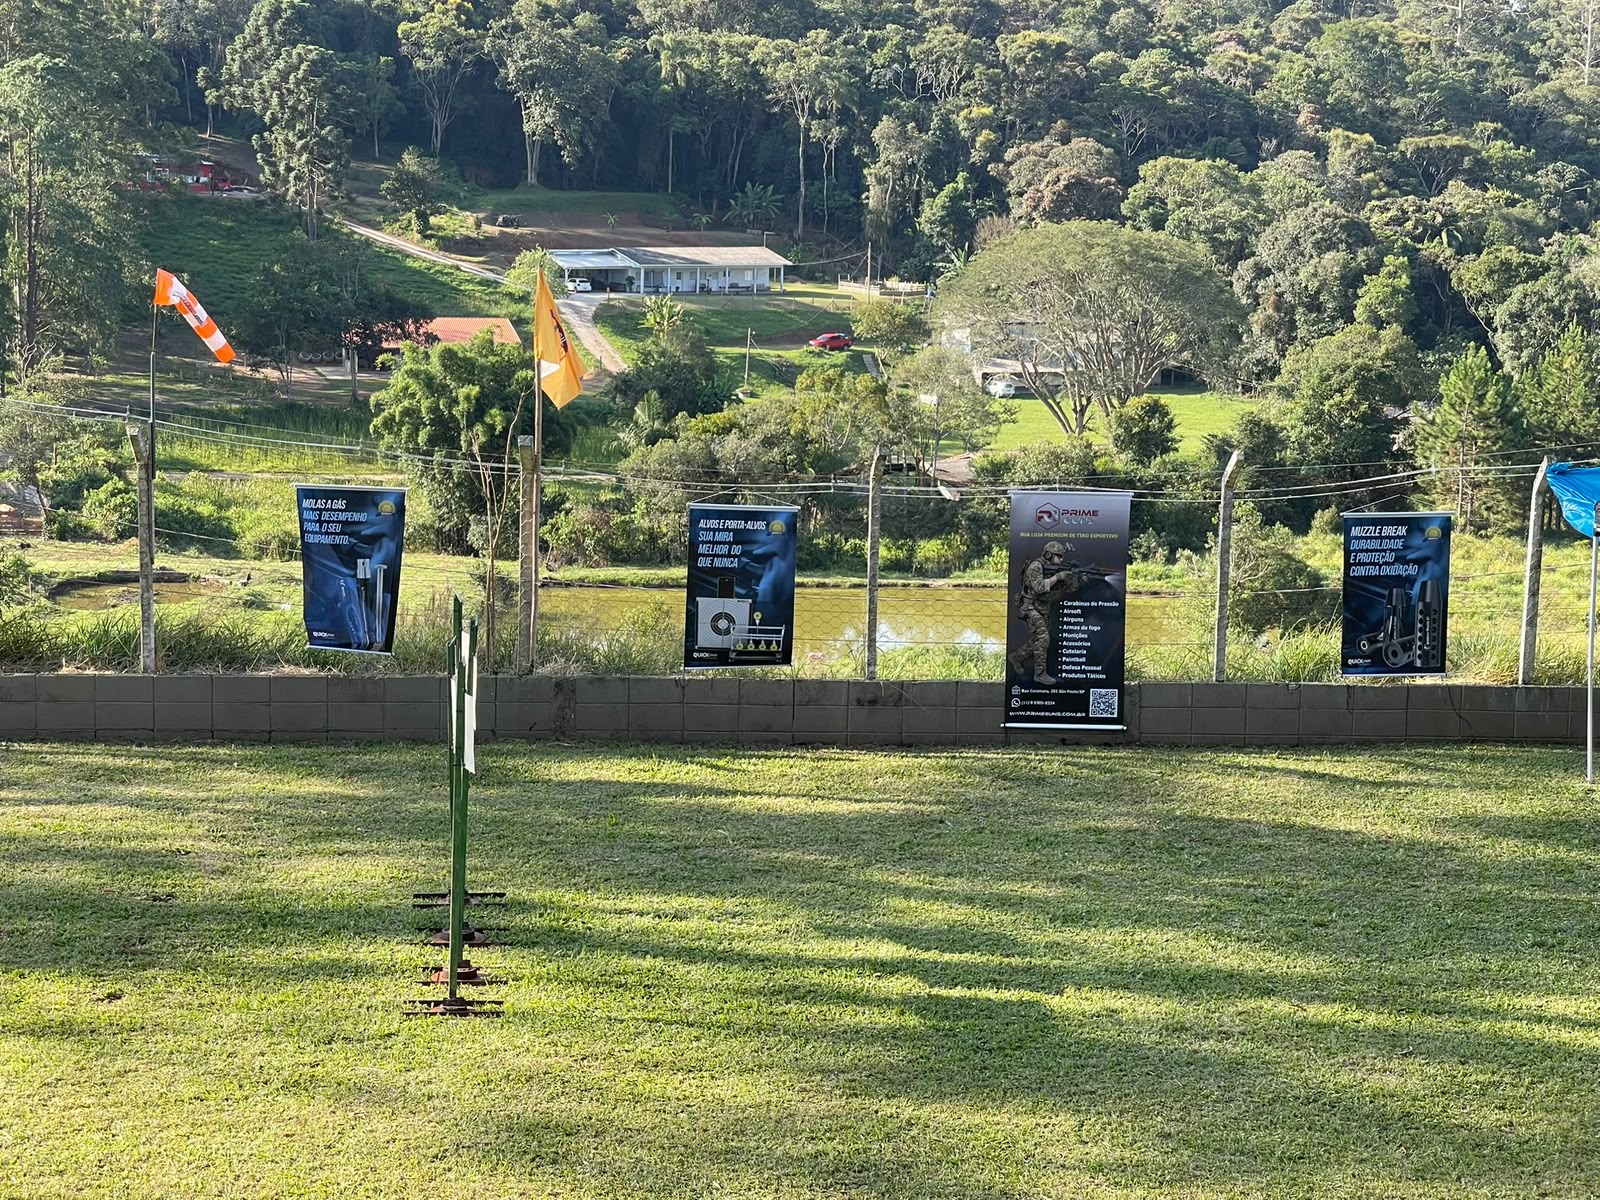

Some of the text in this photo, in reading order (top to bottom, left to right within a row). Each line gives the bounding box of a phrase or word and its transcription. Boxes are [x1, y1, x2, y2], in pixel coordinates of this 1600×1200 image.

[302, 498, 347, 509] MOLAS A GÁS
[303, 510, 367, 522] MAIS DESEMPENHO
[1061, 509, 1099, 517] PRIME
[303, 521, 342, 533] PARA O SEU
[698, 519, 767, 530] ALVOS E PORTA-ALVOS
[698, 531, 734, 542] SUA MIRA
[1350, 525, 1409, 537] MUZZLE BREAK
[304, 532, 350, 545] EQUIPAMENTO.
[1350, 539, 1405, 550] DURABILIDADE
[697, 543, 742, 555] MELHOR DO
[697, 556, 738, 568] QUE NUNCA
[1349, 551, 1395, 565] E PROTEÇÃO
[1349, 563, 1419, 577] CONTRA OXIDAÇÃO
